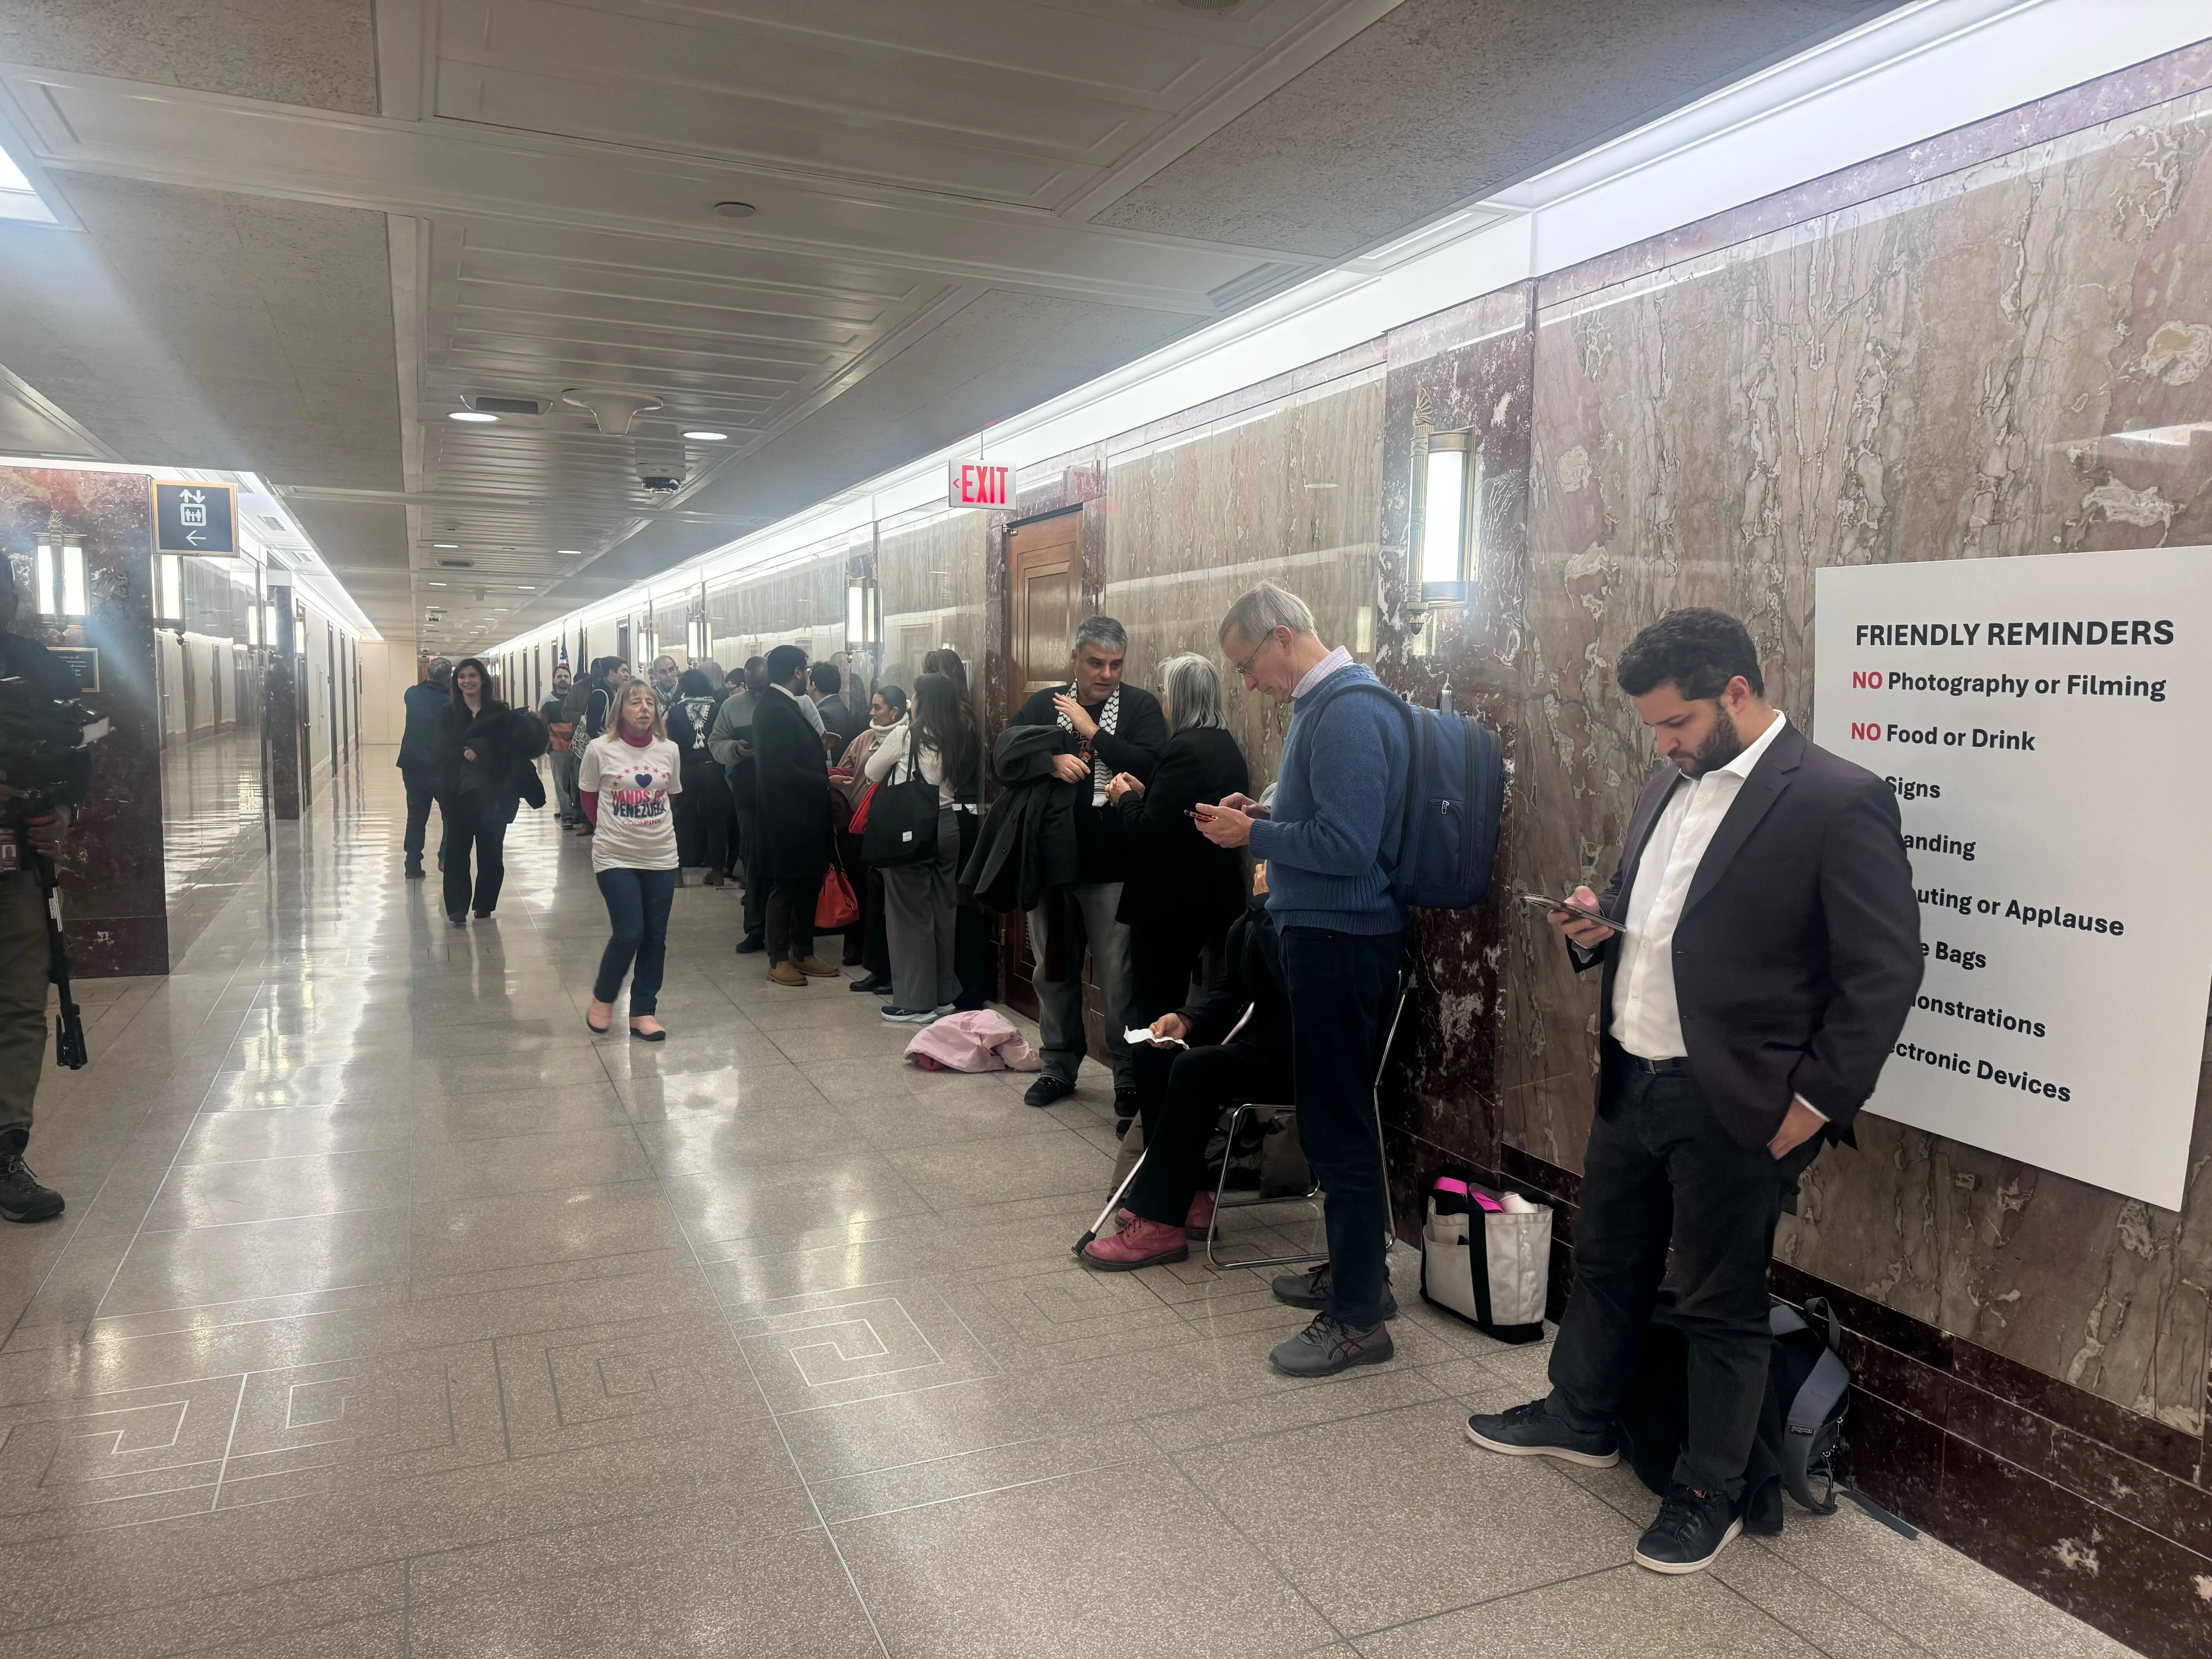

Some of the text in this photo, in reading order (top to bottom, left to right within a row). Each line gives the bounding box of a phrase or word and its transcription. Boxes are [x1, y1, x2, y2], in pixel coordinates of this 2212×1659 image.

[962, 465, 1008, 504] EXIT
[1856, 620, 2174, 646] FRIENDLY REMINDERS
[1853, 671, 2166, 702] NO Photography or Filming
[1851, 722, 2035, 750] NO Food or Drink
[611, 790, 650, 805] HANDS
[1885, 776, 1940, 800] Signs
[1904, 834, 1976, 861] anding
[1916, 888, 2124, 936] uting or Applause
[1936, 941, 1986, 970] Bags
[1912, 994, 2045, 1037] onstrations
[1890, 1043, 2071, 1102] ctronic Devices
